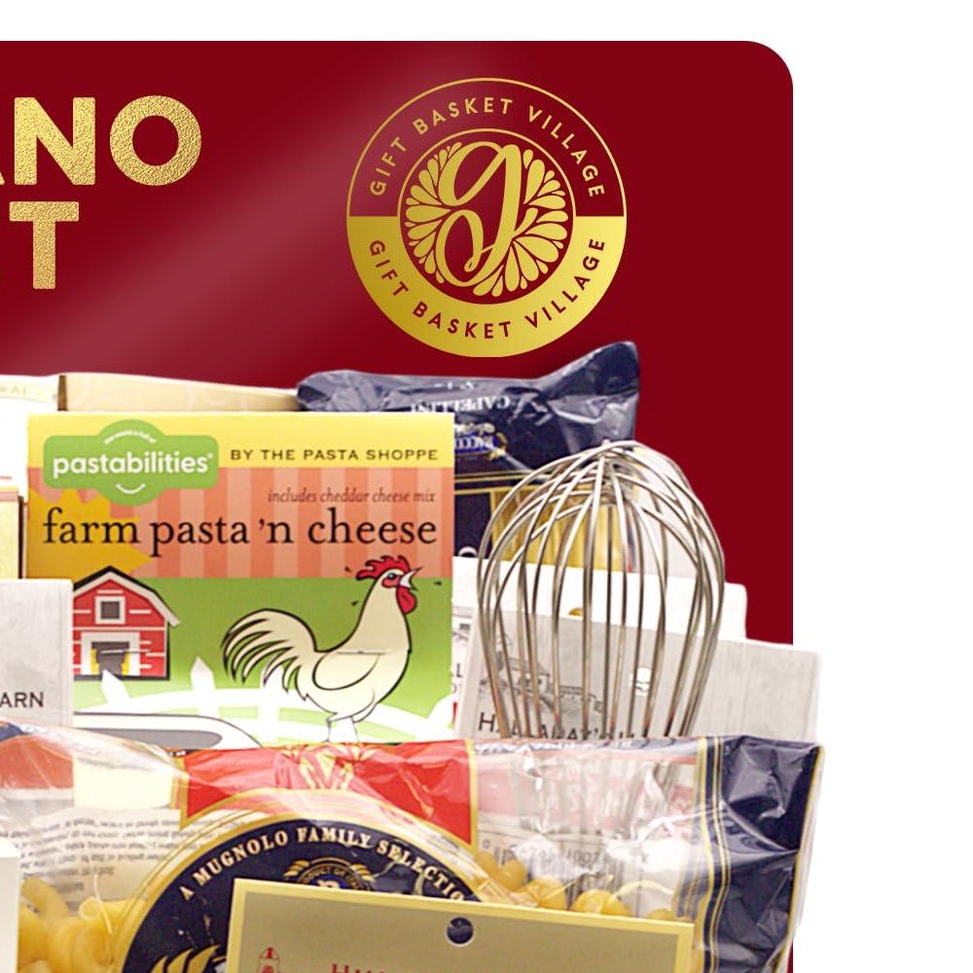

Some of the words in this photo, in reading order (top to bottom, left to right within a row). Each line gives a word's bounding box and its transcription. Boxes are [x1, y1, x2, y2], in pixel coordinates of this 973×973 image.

[52, 450, 210, 479] pastabilities
[230, 448, 253, 461] BY
[260, 448, 296, 461] THE
[302, 448, 360, 461] PASTA
[365, 448, 439, 461] SHOPPE
[267, 486, 317, 503] includes
[319, 486, 370, 504] cheddar
[371, 488, 410, 503] cheese
[412, 489, 436, 503] mix
[42, 506, 142, 545] farm
[148, 516, 249, 558] pasta
[307, 507, 438, 545] cheese
[178, 885, 195, 901] A
[192, 829, 289, 887] MUGNOLO
[296, 826, 373, 848] FAMILY
